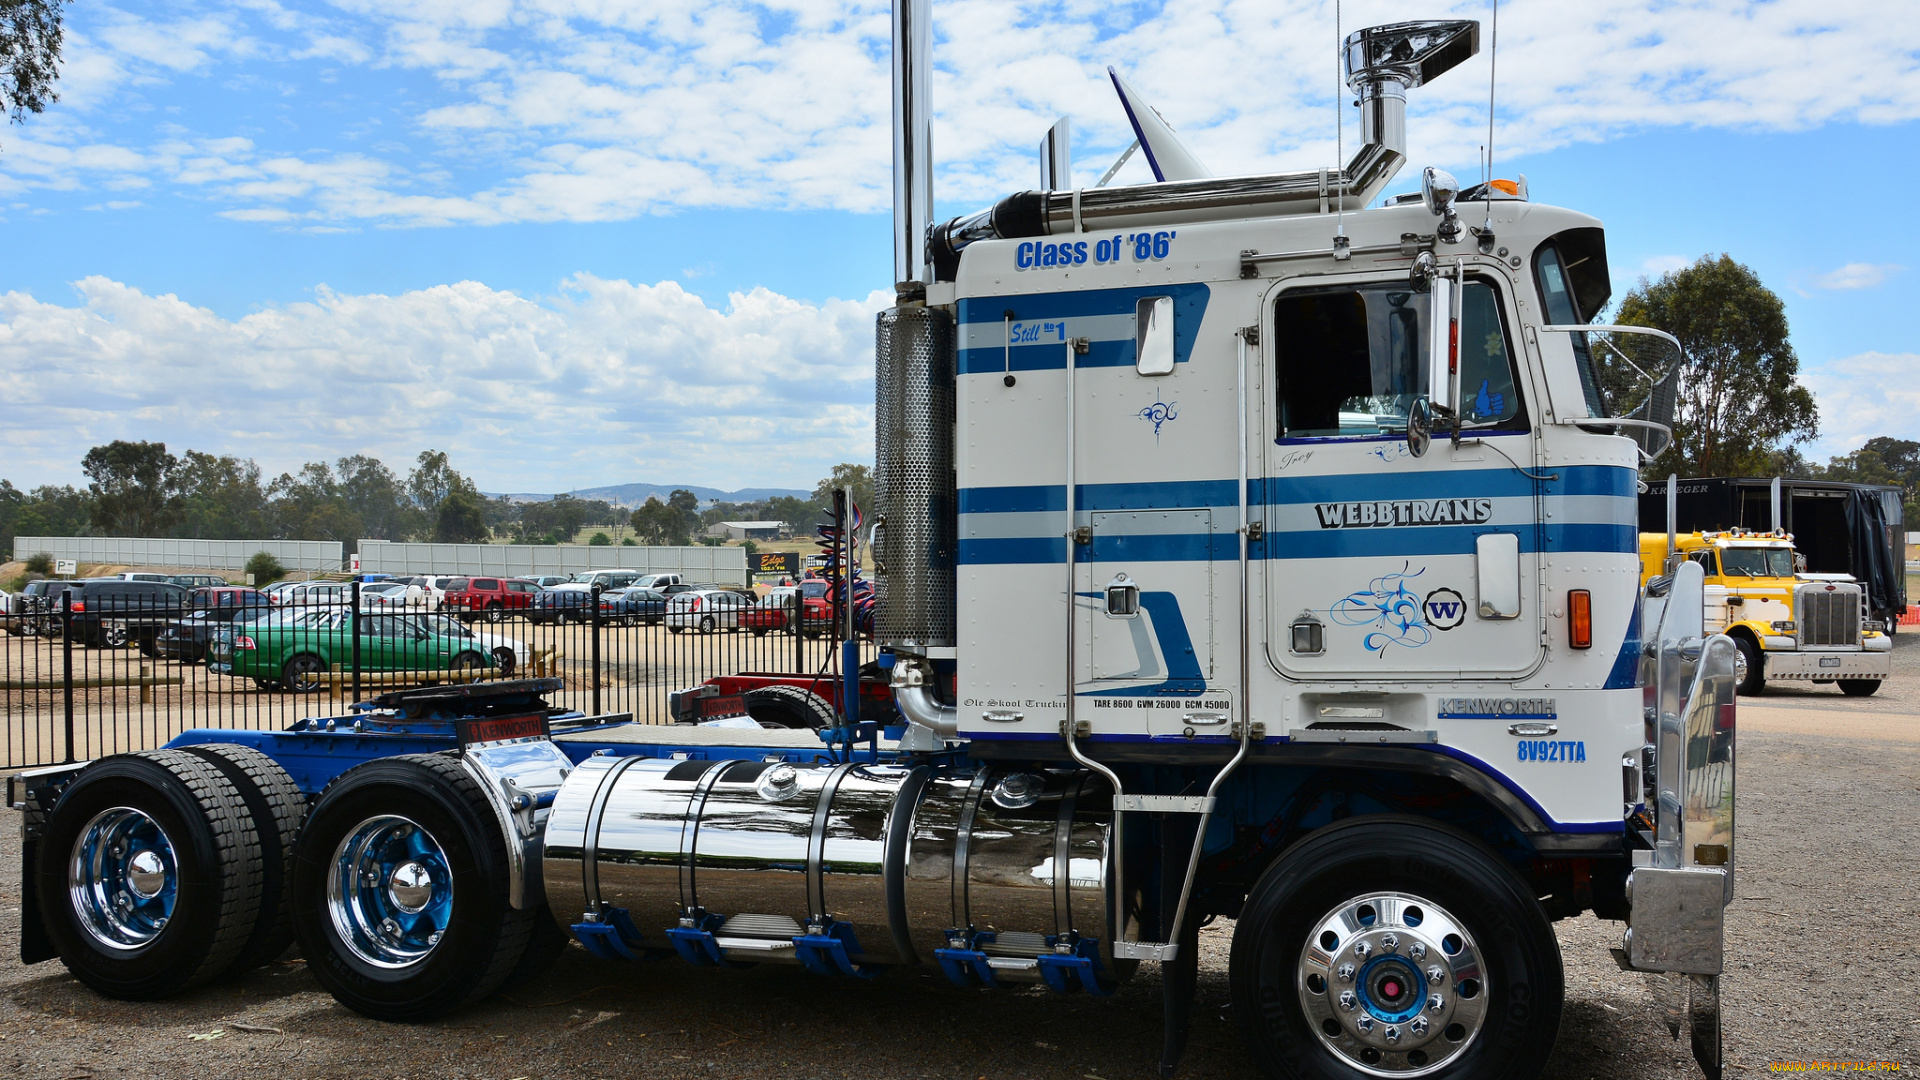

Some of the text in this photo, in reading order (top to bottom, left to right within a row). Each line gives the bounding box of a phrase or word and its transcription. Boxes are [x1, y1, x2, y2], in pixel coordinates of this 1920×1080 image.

[1015, 231, 1177, 270] Class of '86'
[1010, 322, 1041, 343] Still
[1650, 485, 1709, 495] KREGER
[1314, 499, 1493, 529] WEBBTRANS
[57, 560, 66, 571] P
[760, 554, 785, 567] Edge
[1428, 602, 1461, 619] W
[963, 698, 984, 708] Ole
[986, 698, 1021, 708] Skool
[1093, 699, 1230, 710] TARE 8600 GVM 26000 GCM 45000
[1438, 698, 1556, 715] KENWORTH
[481, 719, 541, 739] KENWORTH
[1517, 740, 1587, 763] 8V92TTA
